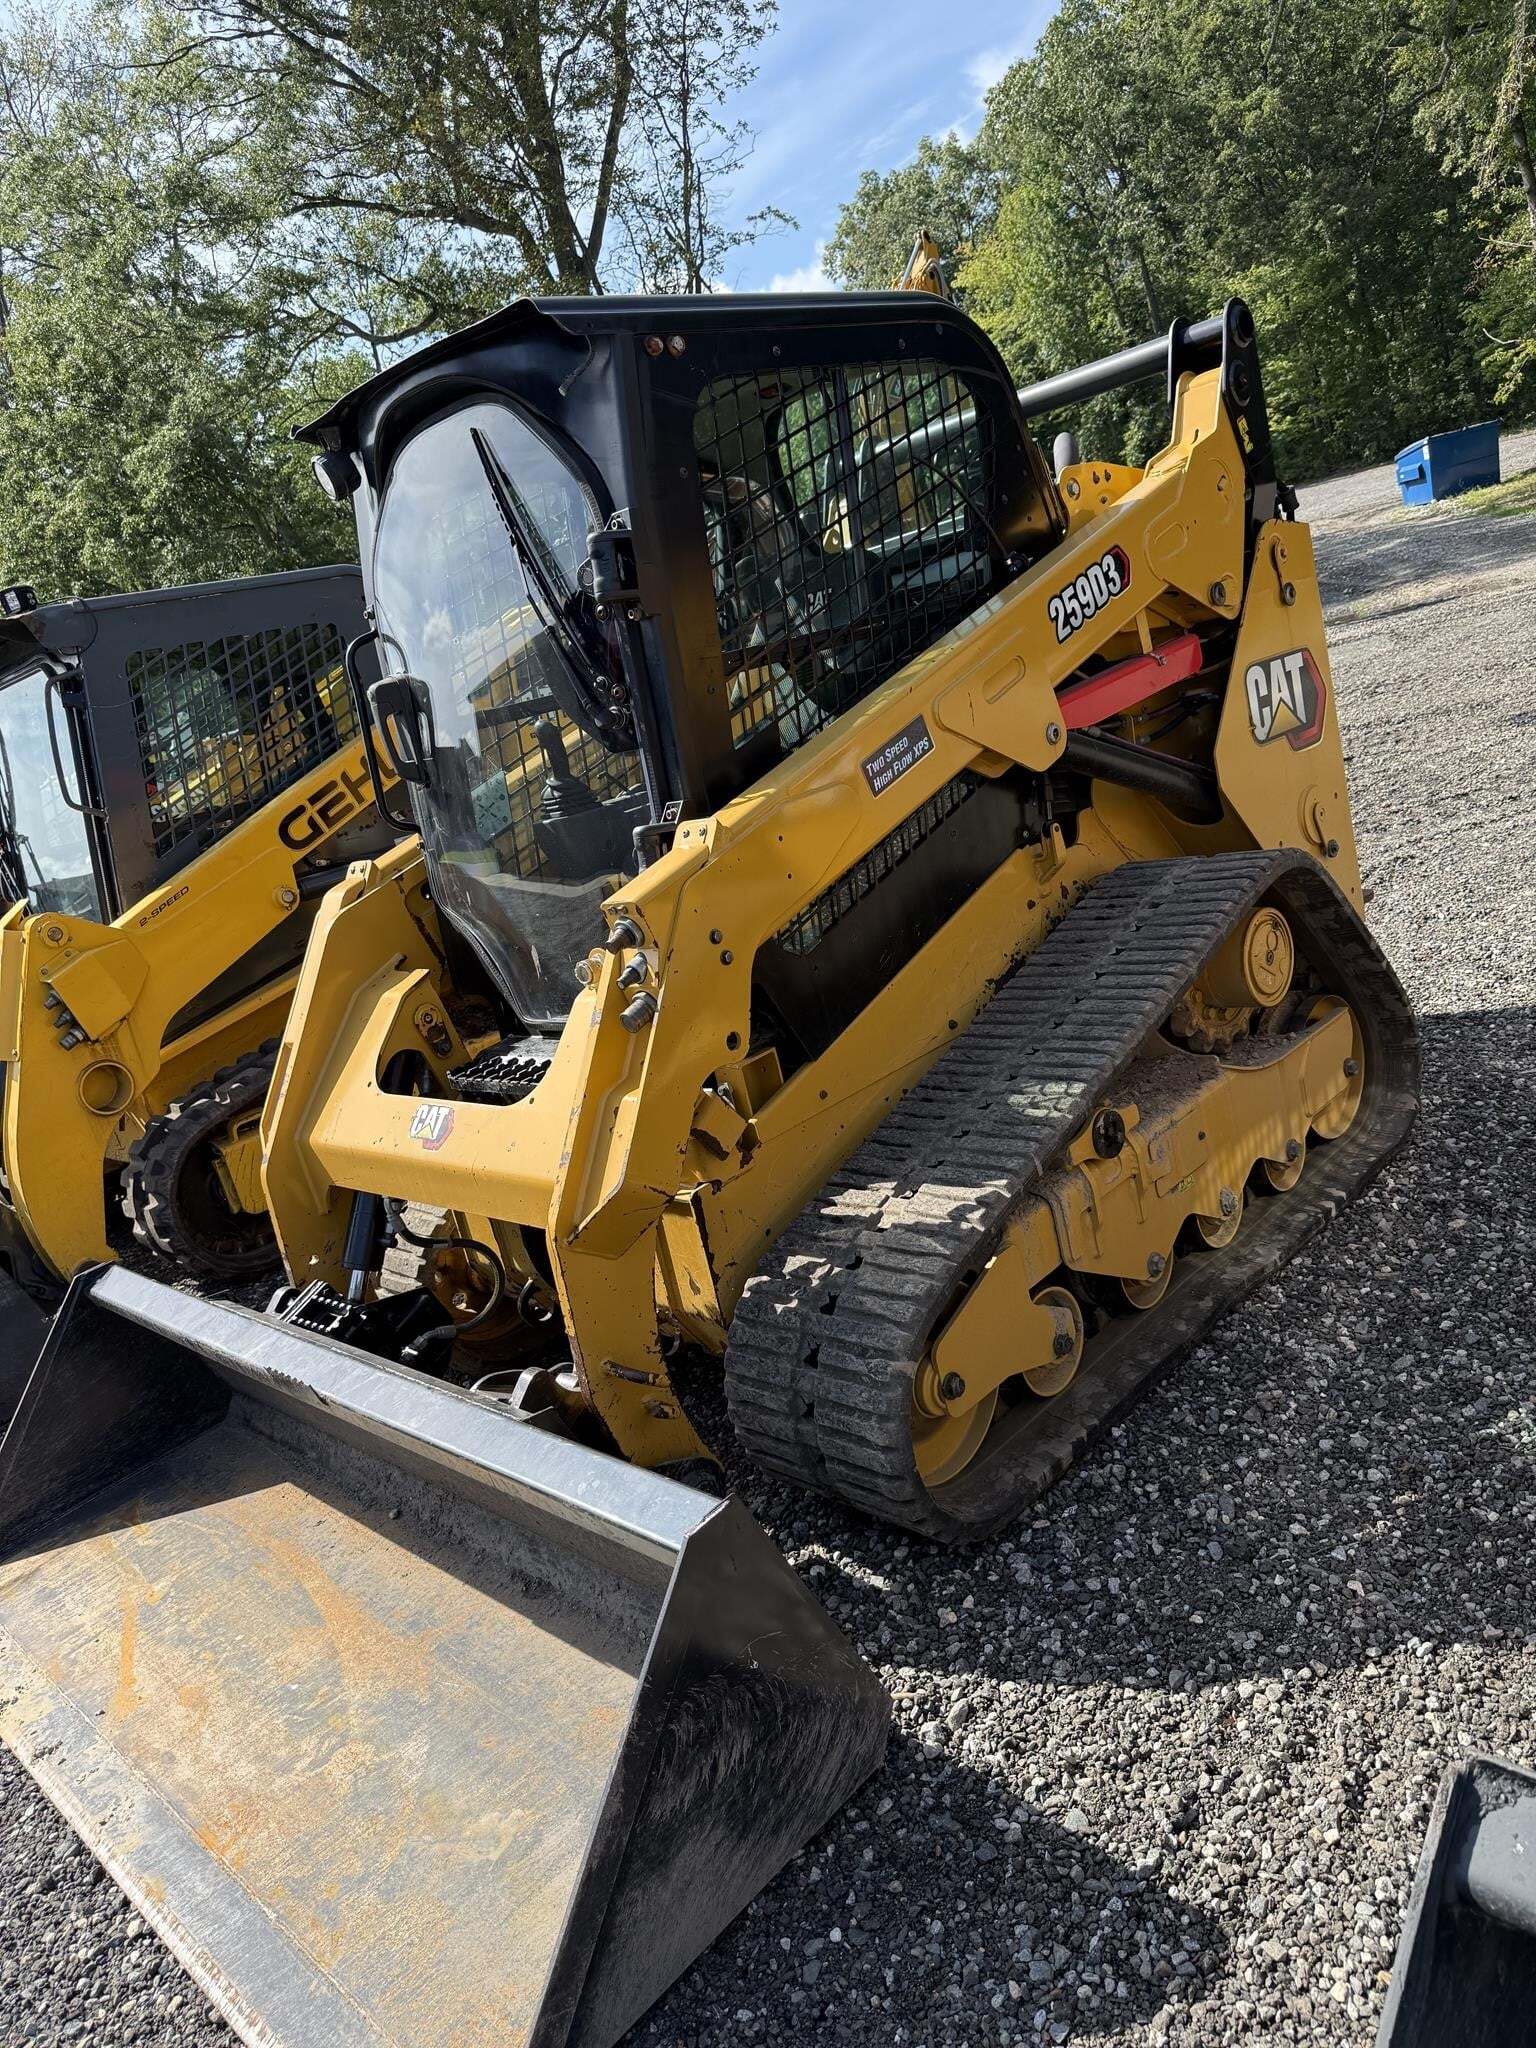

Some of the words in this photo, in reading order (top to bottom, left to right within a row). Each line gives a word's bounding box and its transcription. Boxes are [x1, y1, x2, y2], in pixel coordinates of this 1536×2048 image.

[1049, 554, 1122, 641] 259D3
[1246, 652, 1307, 740] CAT
[866, 756, 885, 776] TWO
[885, 737, 908, 762] SPEED
[873, 768, 893, 791] HIGH
[893, 751, 913, 775] FLOW
[913, 737, 929, 758] XPS
[139, 886, 189, 927] 2-SPEED
[410, 1104, 450, 1140] CAT
